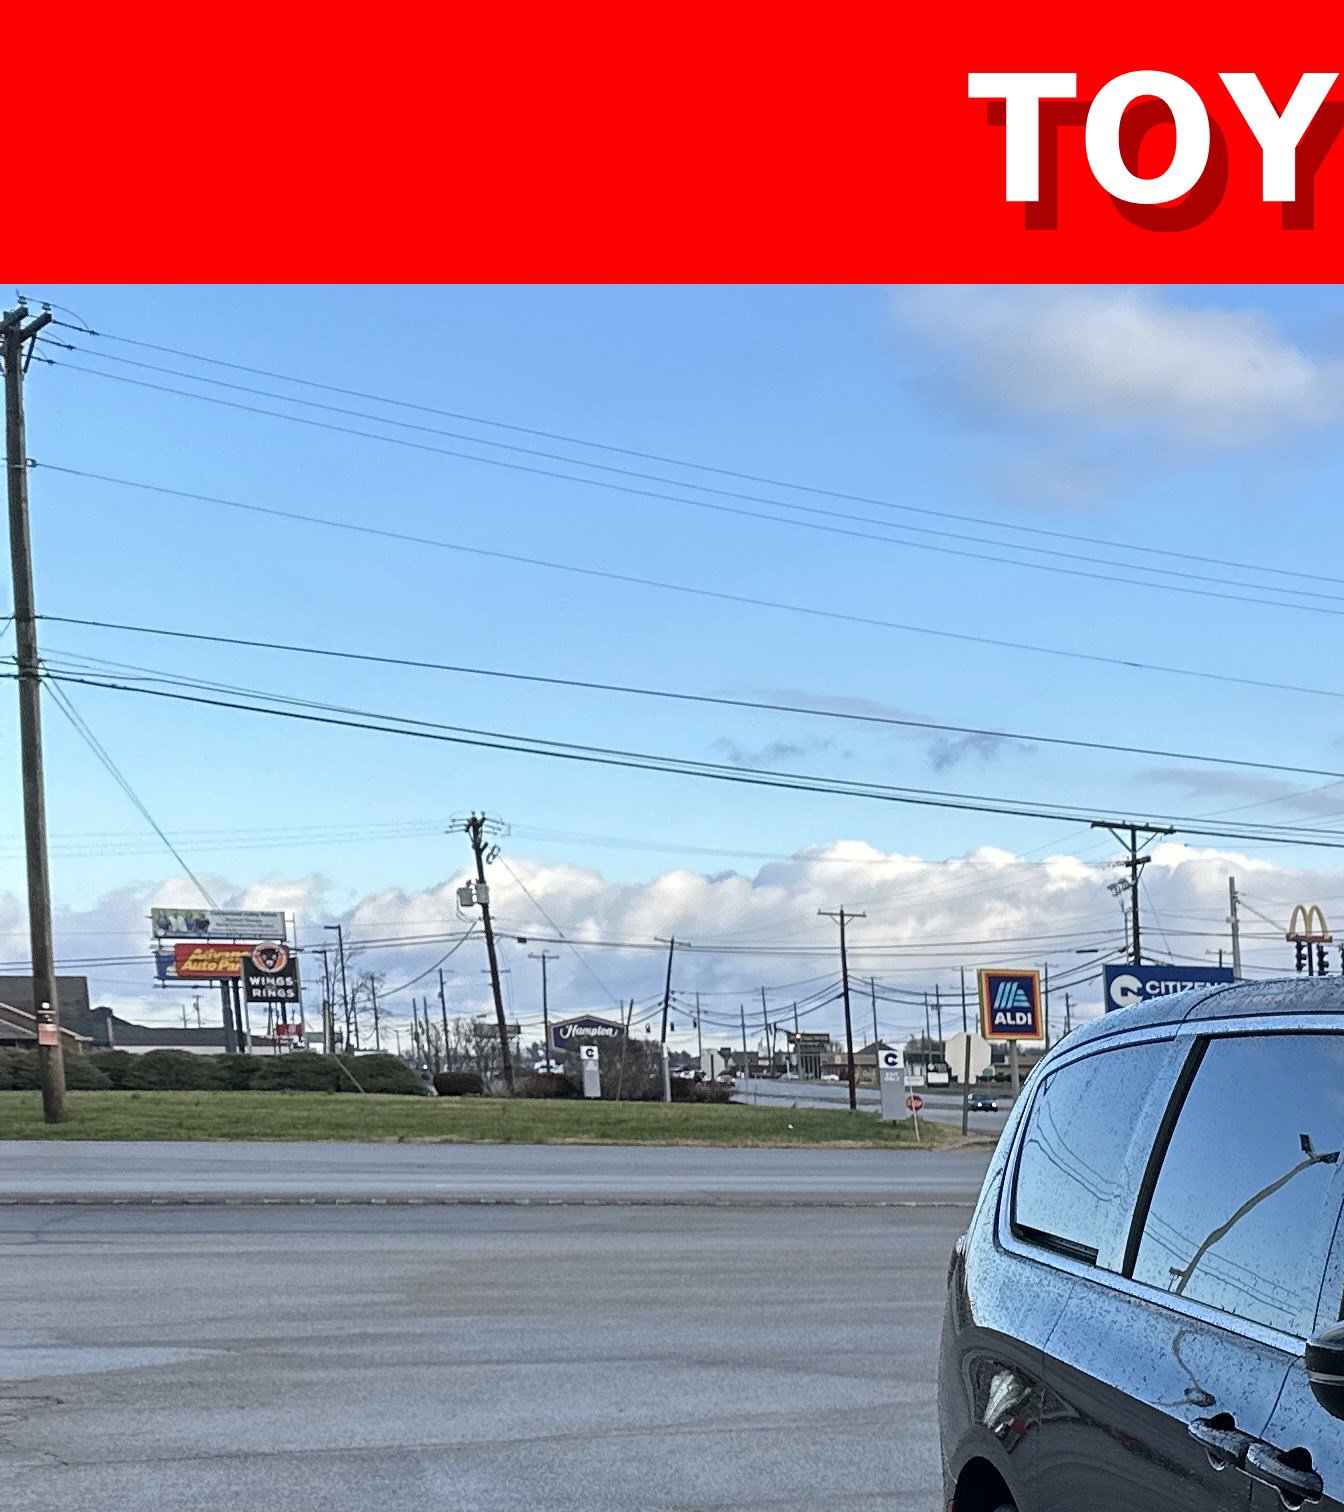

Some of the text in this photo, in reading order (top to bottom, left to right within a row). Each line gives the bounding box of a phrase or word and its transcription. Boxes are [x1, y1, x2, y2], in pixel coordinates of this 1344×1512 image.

[249, 976, 294, 986] WINGS
[251, 988, 296, 998] RINGS
[994, 1011, 1033, 1026] ALDI
[560, 1024, 619, 1039] Hampton
